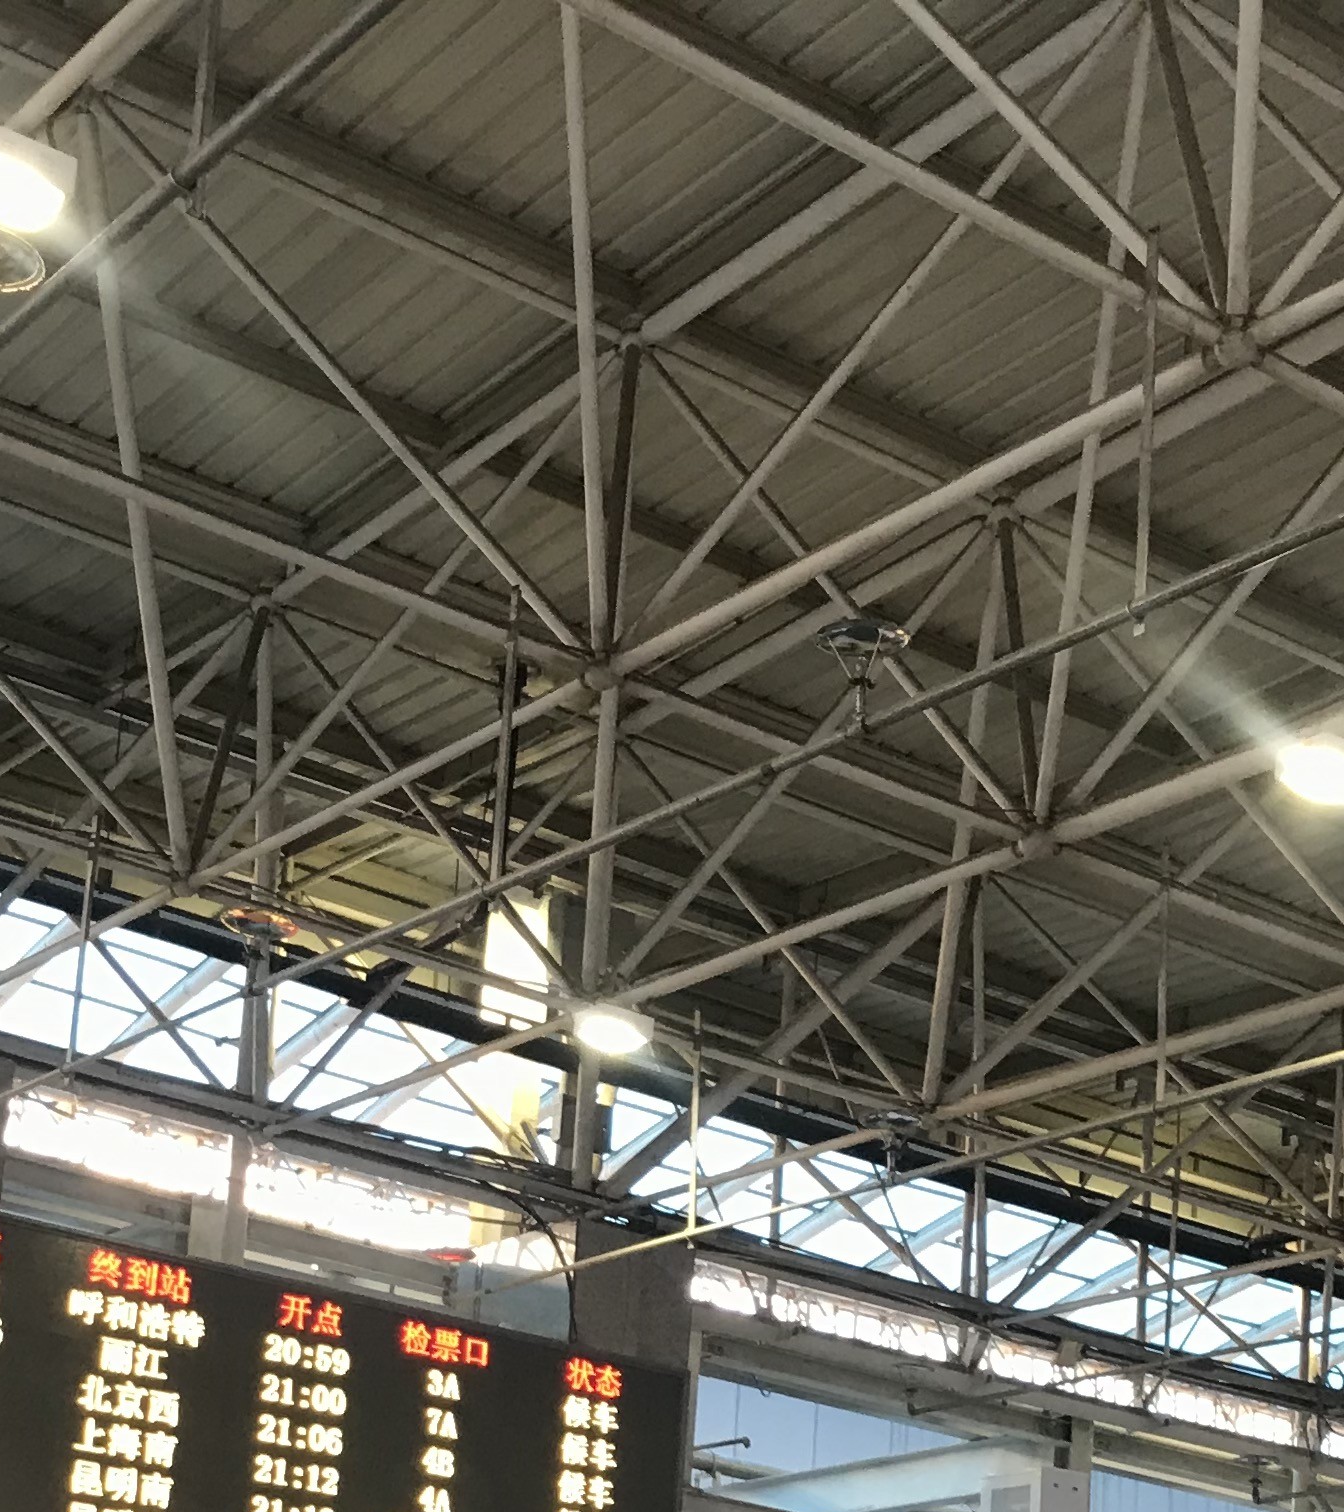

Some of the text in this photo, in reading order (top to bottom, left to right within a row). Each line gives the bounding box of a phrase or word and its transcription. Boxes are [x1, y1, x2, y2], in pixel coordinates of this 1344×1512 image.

[67, 1288, 206, 1348] 呼和浩特
[263, 1333, 351, 1376] 20:59
[427, 1369, 461, 1401] 3A
[562, 1394, 619, 1434] 候车
[87, 1248, 192, 1305] 终到站
[278, 1293, 343, 1337] 开点
[400, 1320, 490, 1367] 检票口
[565, 1357, 623, 1399] 状态
[73, 1417, 179, 1468] 上海南
[253, 1453, 340, 1496] 21:12
[76, 1374, 181, 1428] 北京西
[256, 1413, 344, 1456] 21:06
[421, 1445, 455, 1478] 4B
[557, 1469, 616, 1510] 候车
[99, 1335, 169, 1380] 丽江
[260, 1373, 347, 1416] 21:00
[425, 1407, 459, 1440] 7A
[560, 1431, 618, 1472] 候车
[69, 1459, 175, 1510] 昆明南
